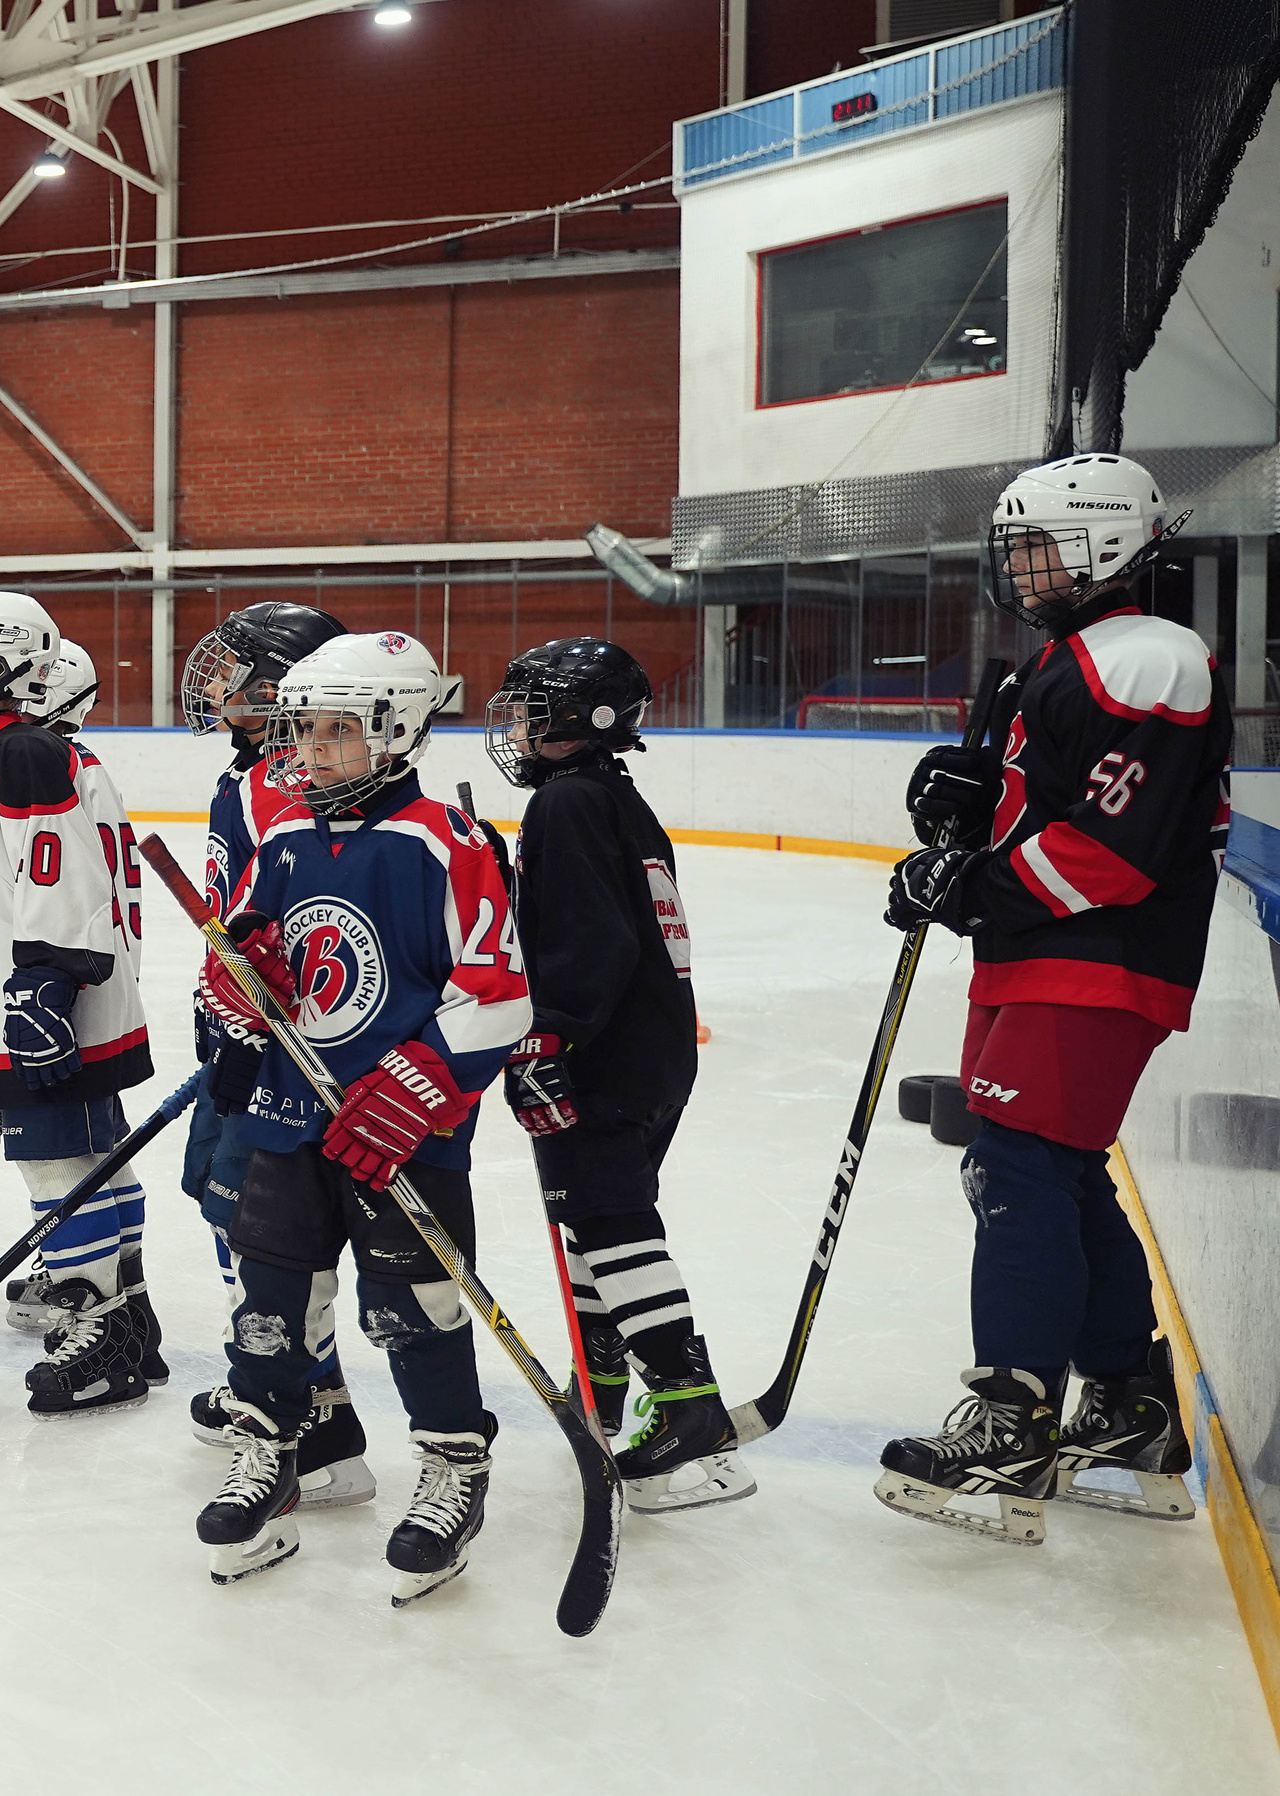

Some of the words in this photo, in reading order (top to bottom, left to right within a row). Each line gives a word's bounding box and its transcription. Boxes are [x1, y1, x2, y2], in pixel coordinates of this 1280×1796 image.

[1066, 501, 1132, 511] MISSION
[281, 684, 314, 693] BAUER
[398, 687, 427, 696] BAUER
[542, 680, 569, 689] CCM
[1085, 751, 1148, 817] 56
[16, 830, 62, 888] 0
[283, 908, 334, 947] HOCKEY
[337, 914, 369, 949] CLUB
[459, 895, 524, 976] 24
[351, 958, 377, 1012] VIKHR
[377, 1048, 447, 1111] RRIOR
[969, 1075, 1020, 1104] CM
[543, 1189, 567, 1201] UER
[812, 1136, 862, 1272] CCM
[27, 1215, 61, 1249] NDW300
[651, 1437, 679, 1460] BAUER
